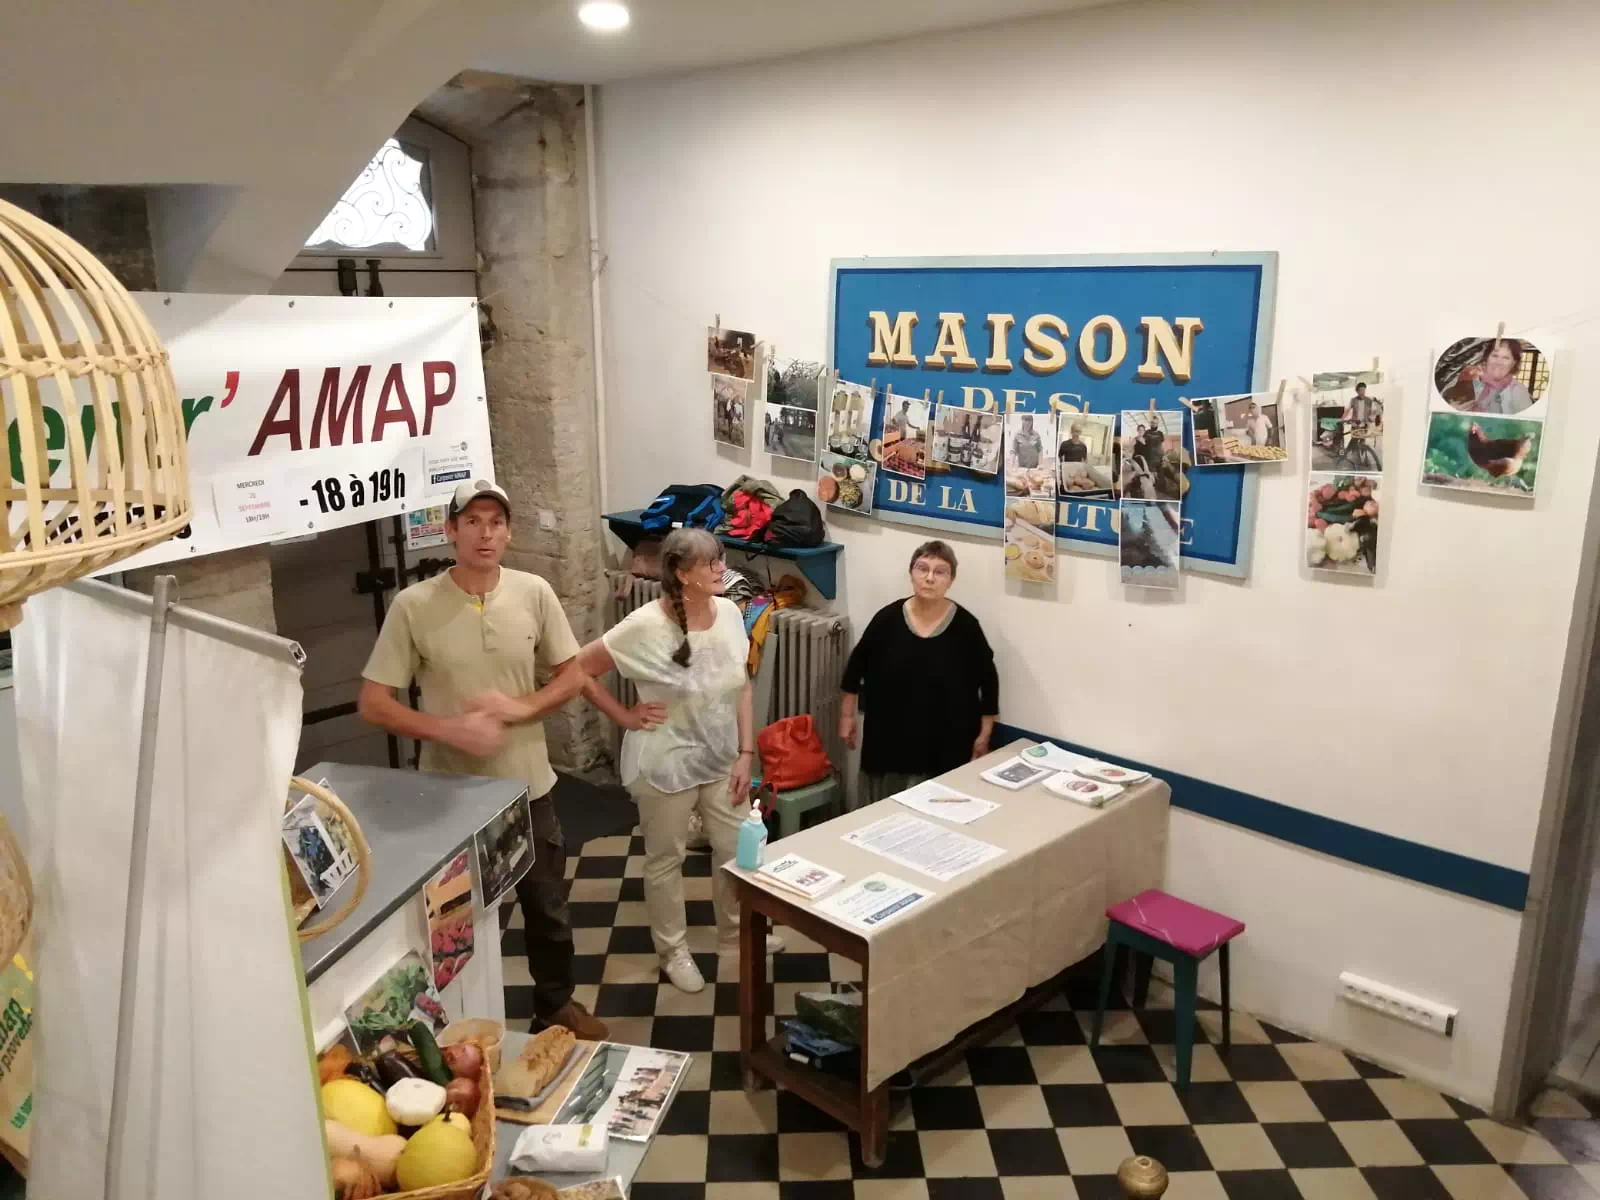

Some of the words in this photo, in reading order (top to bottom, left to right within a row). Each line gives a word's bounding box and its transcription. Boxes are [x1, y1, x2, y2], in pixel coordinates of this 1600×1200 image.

[867, 310, 1204, 382] MAISON
[960, 386, 1083, 416] DES
[348, 473, 365, 508] à
[887, 478, 927, 506] DE
[938, 485, 978, 514] LA
